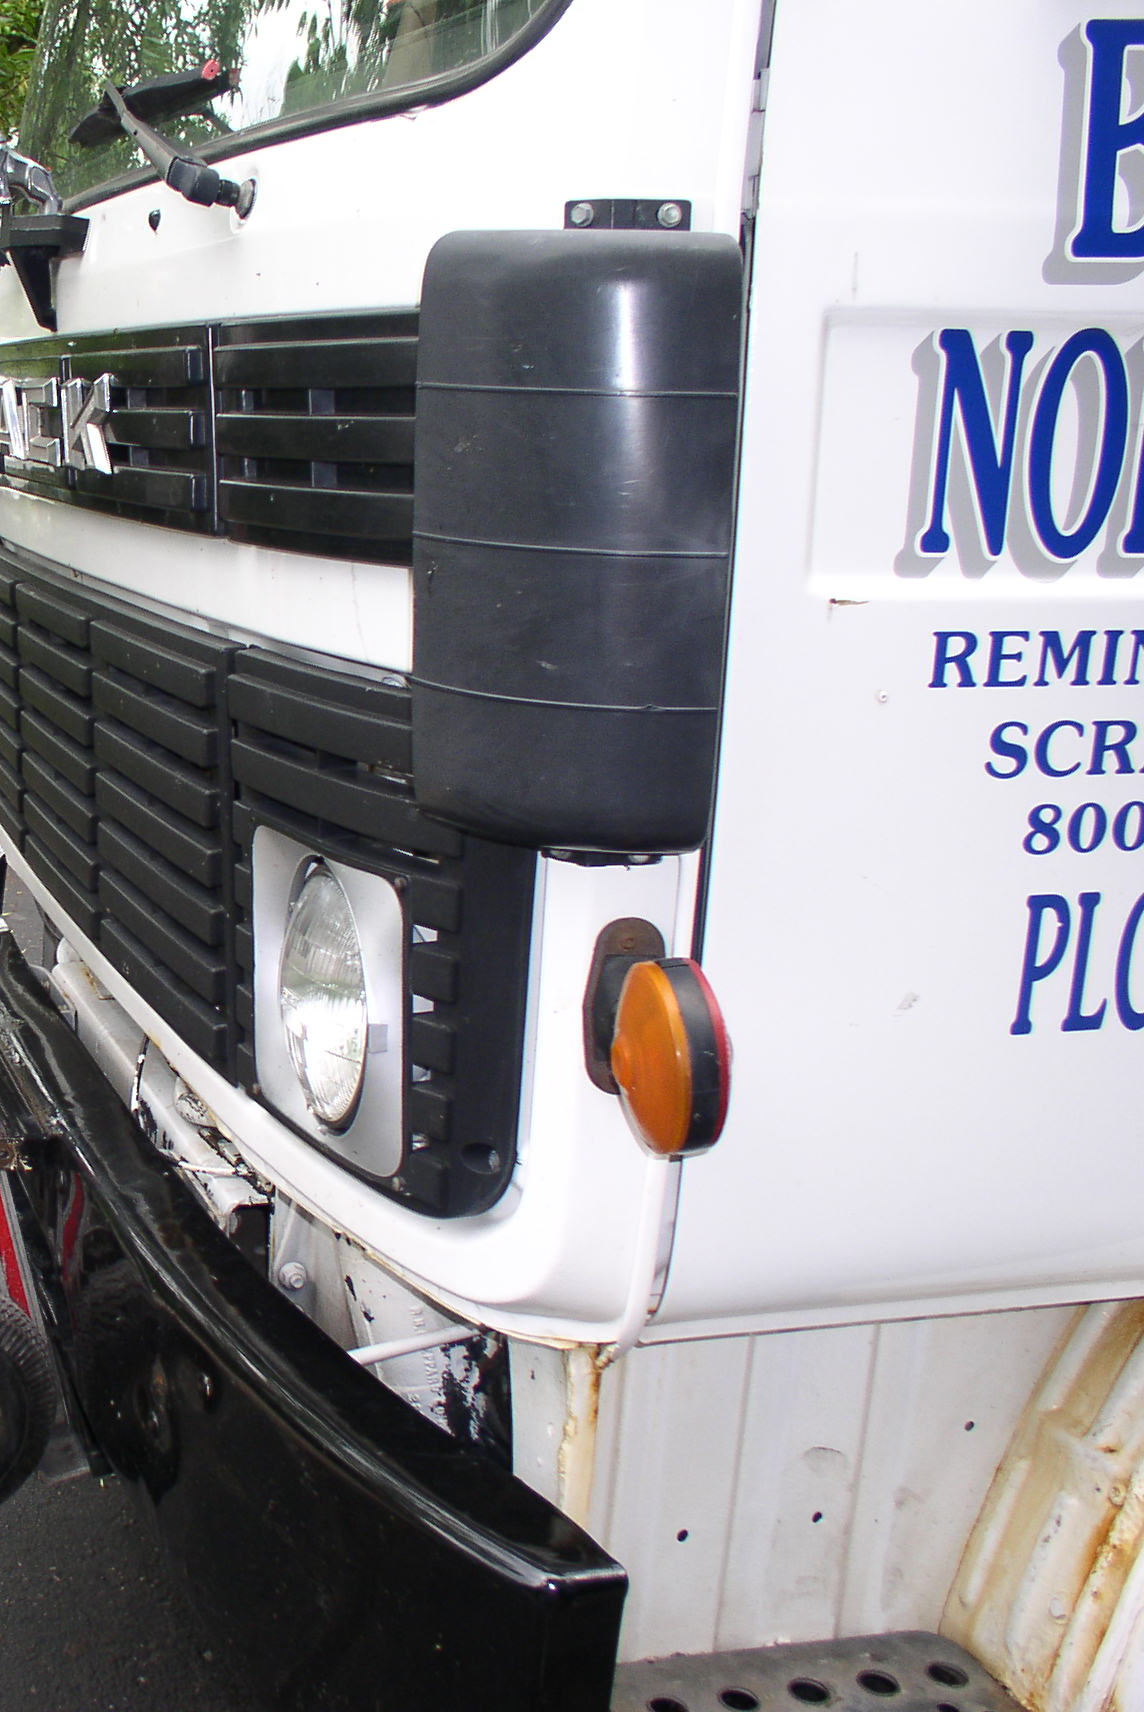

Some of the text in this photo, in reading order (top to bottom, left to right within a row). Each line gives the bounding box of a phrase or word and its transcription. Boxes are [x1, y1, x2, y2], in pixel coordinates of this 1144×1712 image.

[920, 327, 1144, 559] NO
[983, 719, 1144, 780] SCR
[1022, 800, 1144, 856] 800
